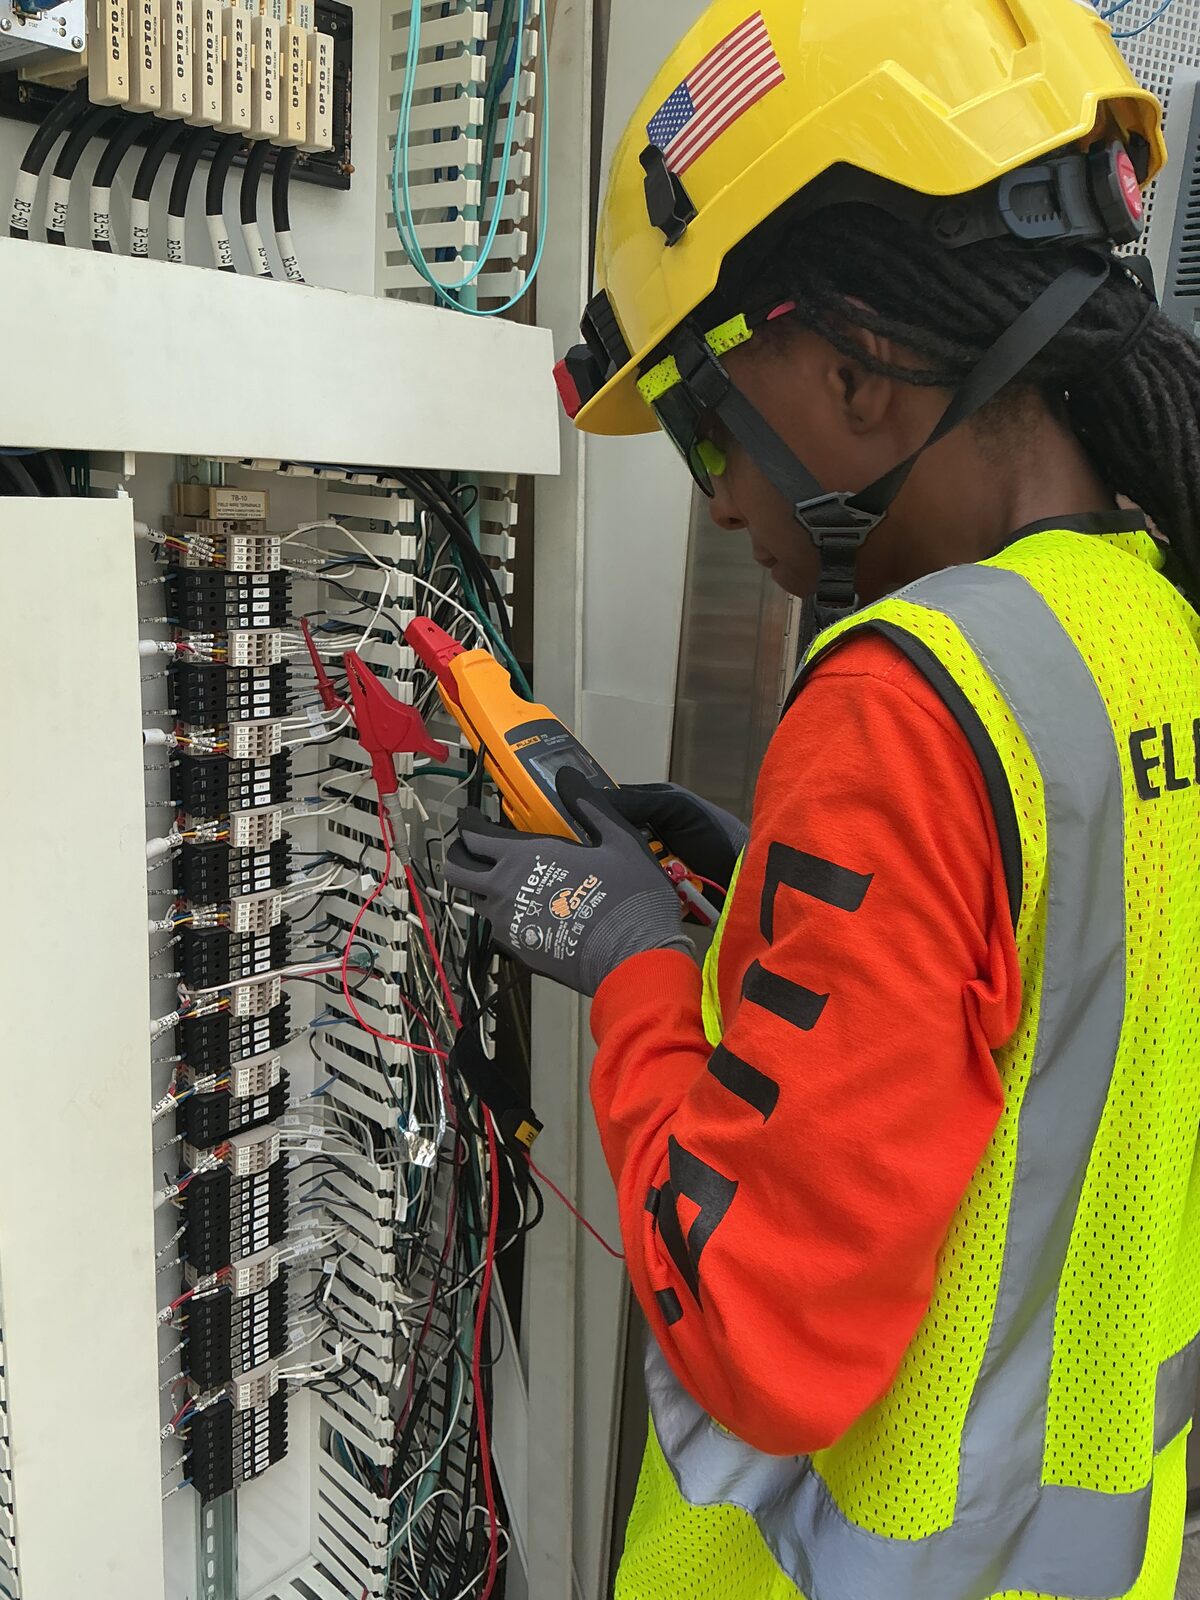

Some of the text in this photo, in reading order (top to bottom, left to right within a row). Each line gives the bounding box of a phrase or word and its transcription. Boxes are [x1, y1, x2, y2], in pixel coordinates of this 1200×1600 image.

[207, 9, 213, 33] 22
[236, 19, 243, 42] 22
[112, 11, 120, 60] OPTO
[144, 0, 152, 69] OPTO 2
[265, 27, 272, 50] 22
[292, 36, 299, 59] 22
[319, 44, 326, 66] 22
[10, 198, 31, 228] R3-S0
[94, 212, 109, 239] R3-S2
[133, 227, 148, 252] R3-S3
[556, 869, 570, 882] 7(S)
[509, 861, 548, 949] MaxiFlex
[591, 891, 607, 908] 4131A
